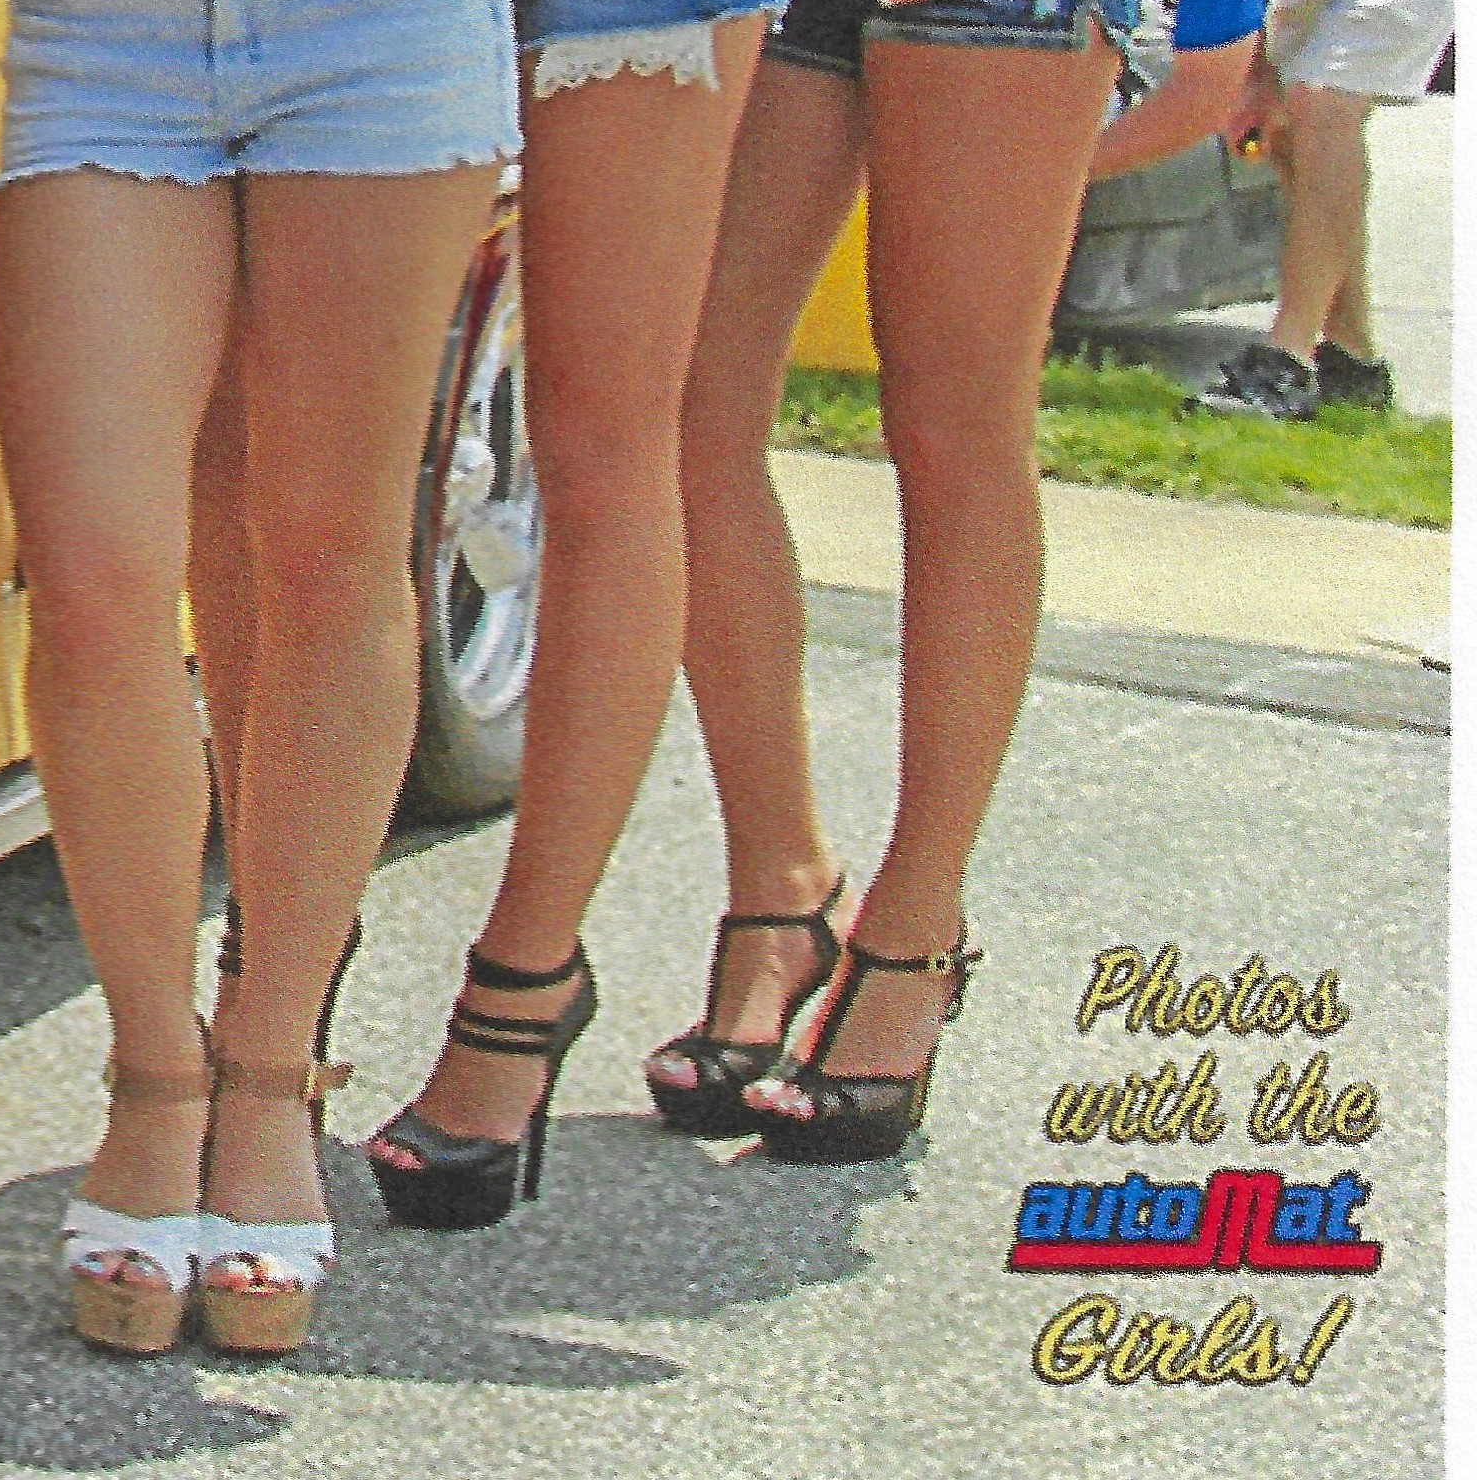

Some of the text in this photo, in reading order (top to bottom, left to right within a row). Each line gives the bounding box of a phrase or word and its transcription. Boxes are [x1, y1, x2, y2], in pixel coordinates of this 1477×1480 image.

[1076, 942, 1350, 1036] Photos
[1044, 1050, 1381, 1144] with the
[1031, 1293, 1353, 1385] Girls!
